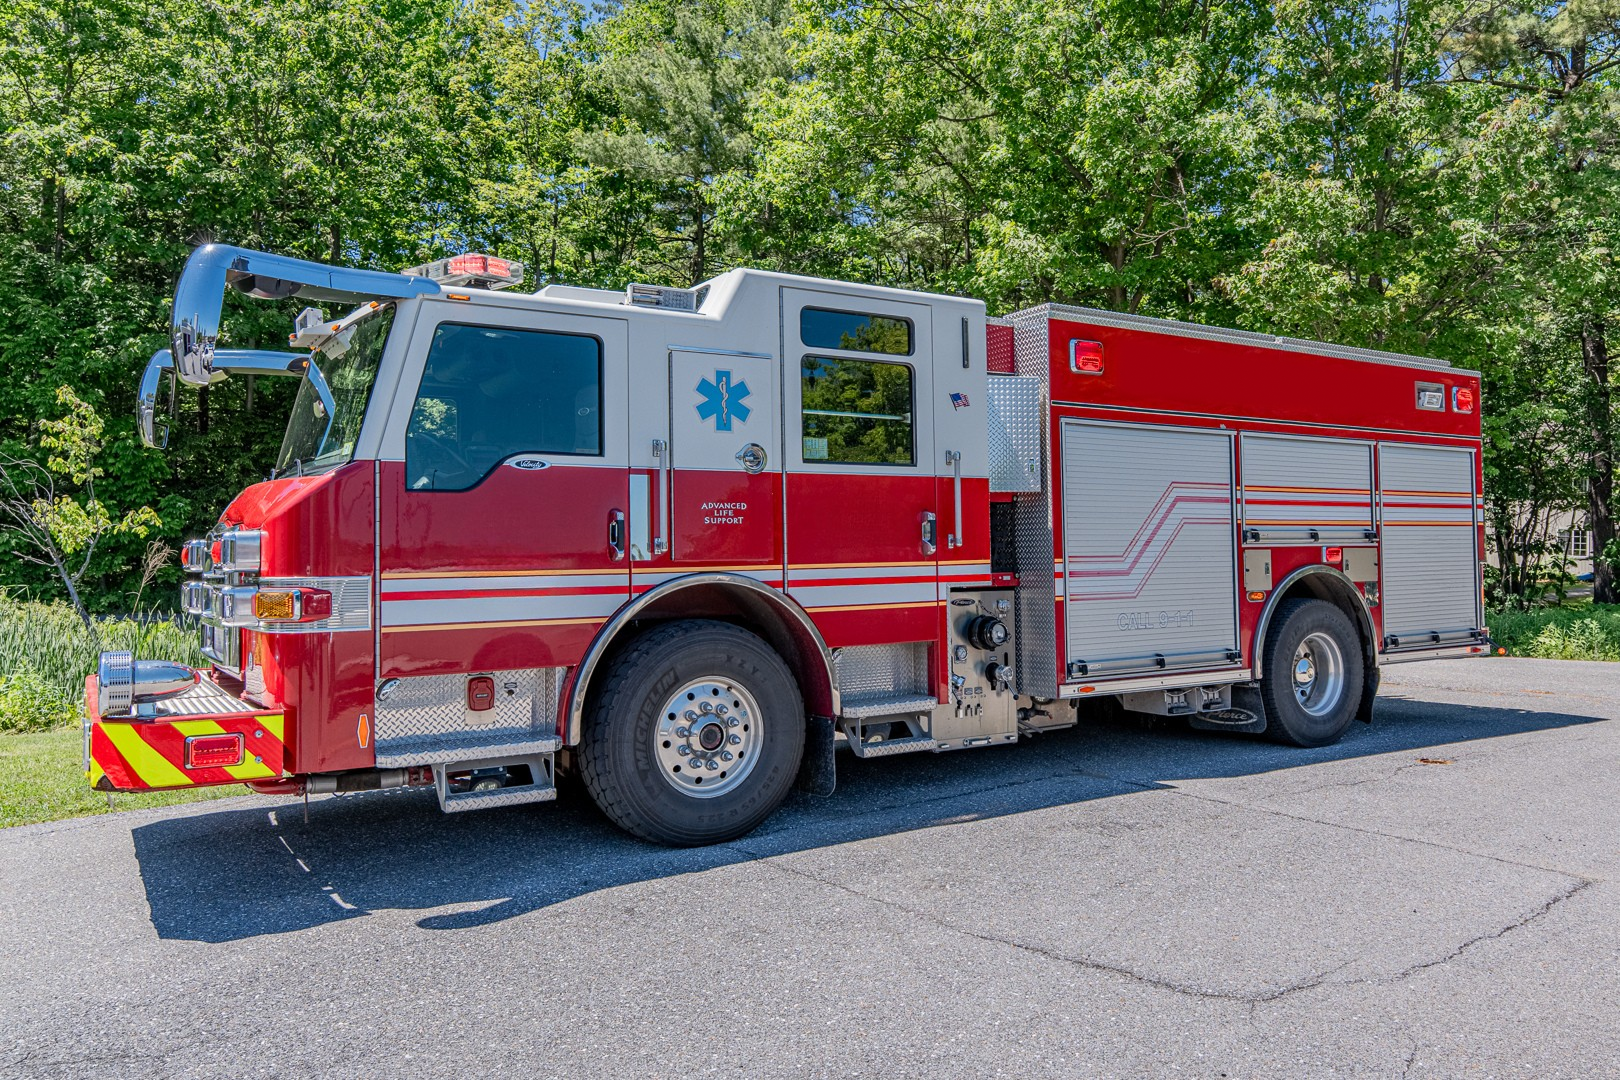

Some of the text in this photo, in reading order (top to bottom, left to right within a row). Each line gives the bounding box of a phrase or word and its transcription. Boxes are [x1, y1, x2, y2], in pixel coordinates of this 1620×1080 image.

[701, 502, 747, 510] ADVANCED
[704, 516, 744, 524] SUPPORT
[1117, 610, 1193, 631] CALL 9-1-1
[635, 669, 677, 770] MICHELIN
